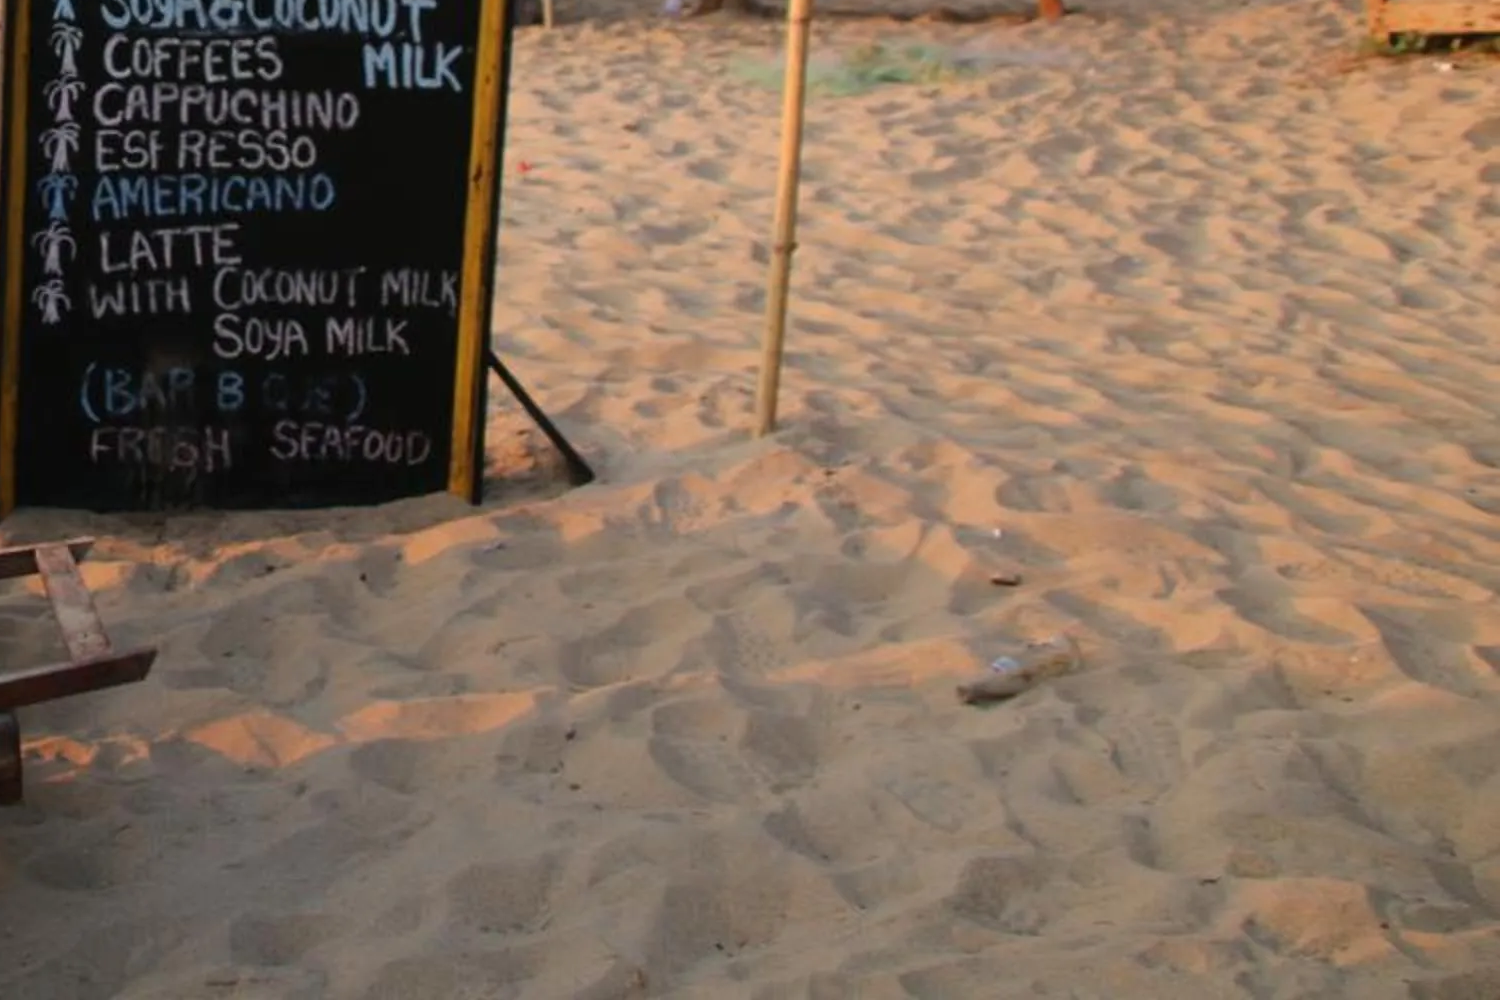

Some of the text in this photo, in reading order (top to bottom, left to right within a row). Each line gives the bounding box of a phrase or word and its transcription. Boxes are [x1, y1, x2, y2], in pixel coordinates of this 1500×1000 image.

[104, 34, 463, 91] COFFEES MILK
[93, 81, 360, 130] CAPPUCHINO
[92, 174, 336, 222] AMERICANO
[100, 222, 242, 273] LATTE
[90, 265, 459, 319] WITH COCONUT MILK
[212, 313, 411, 360] SOYA MILK
